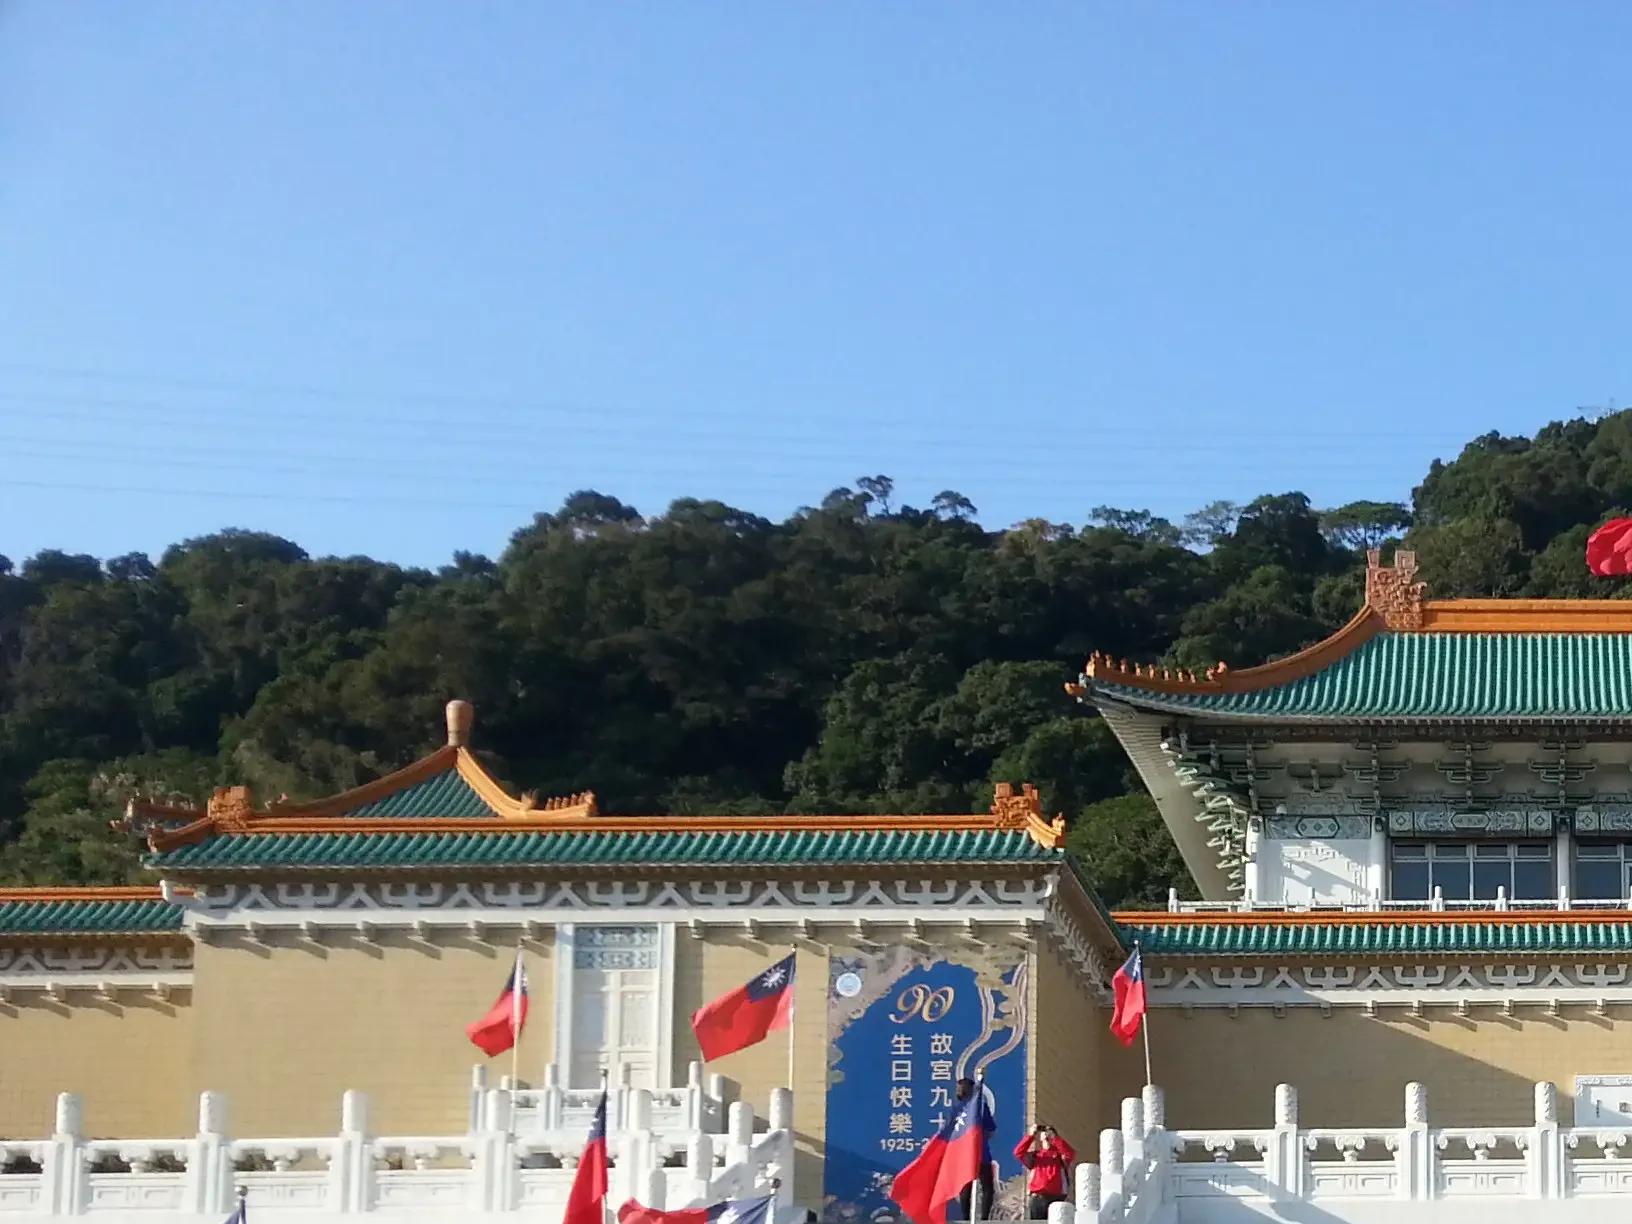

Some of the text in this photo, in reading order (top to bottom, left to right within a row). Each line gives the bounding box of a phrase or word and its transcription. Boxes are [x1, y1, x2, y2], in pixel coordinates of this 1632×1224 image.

[889, 983, 955, 1024] 90
[889, 1034, 912, 1134] 生日快樂
[930, 1033, 953, 1134] 故宮九十
[880, 1138, 930, 1153] 1925-2
